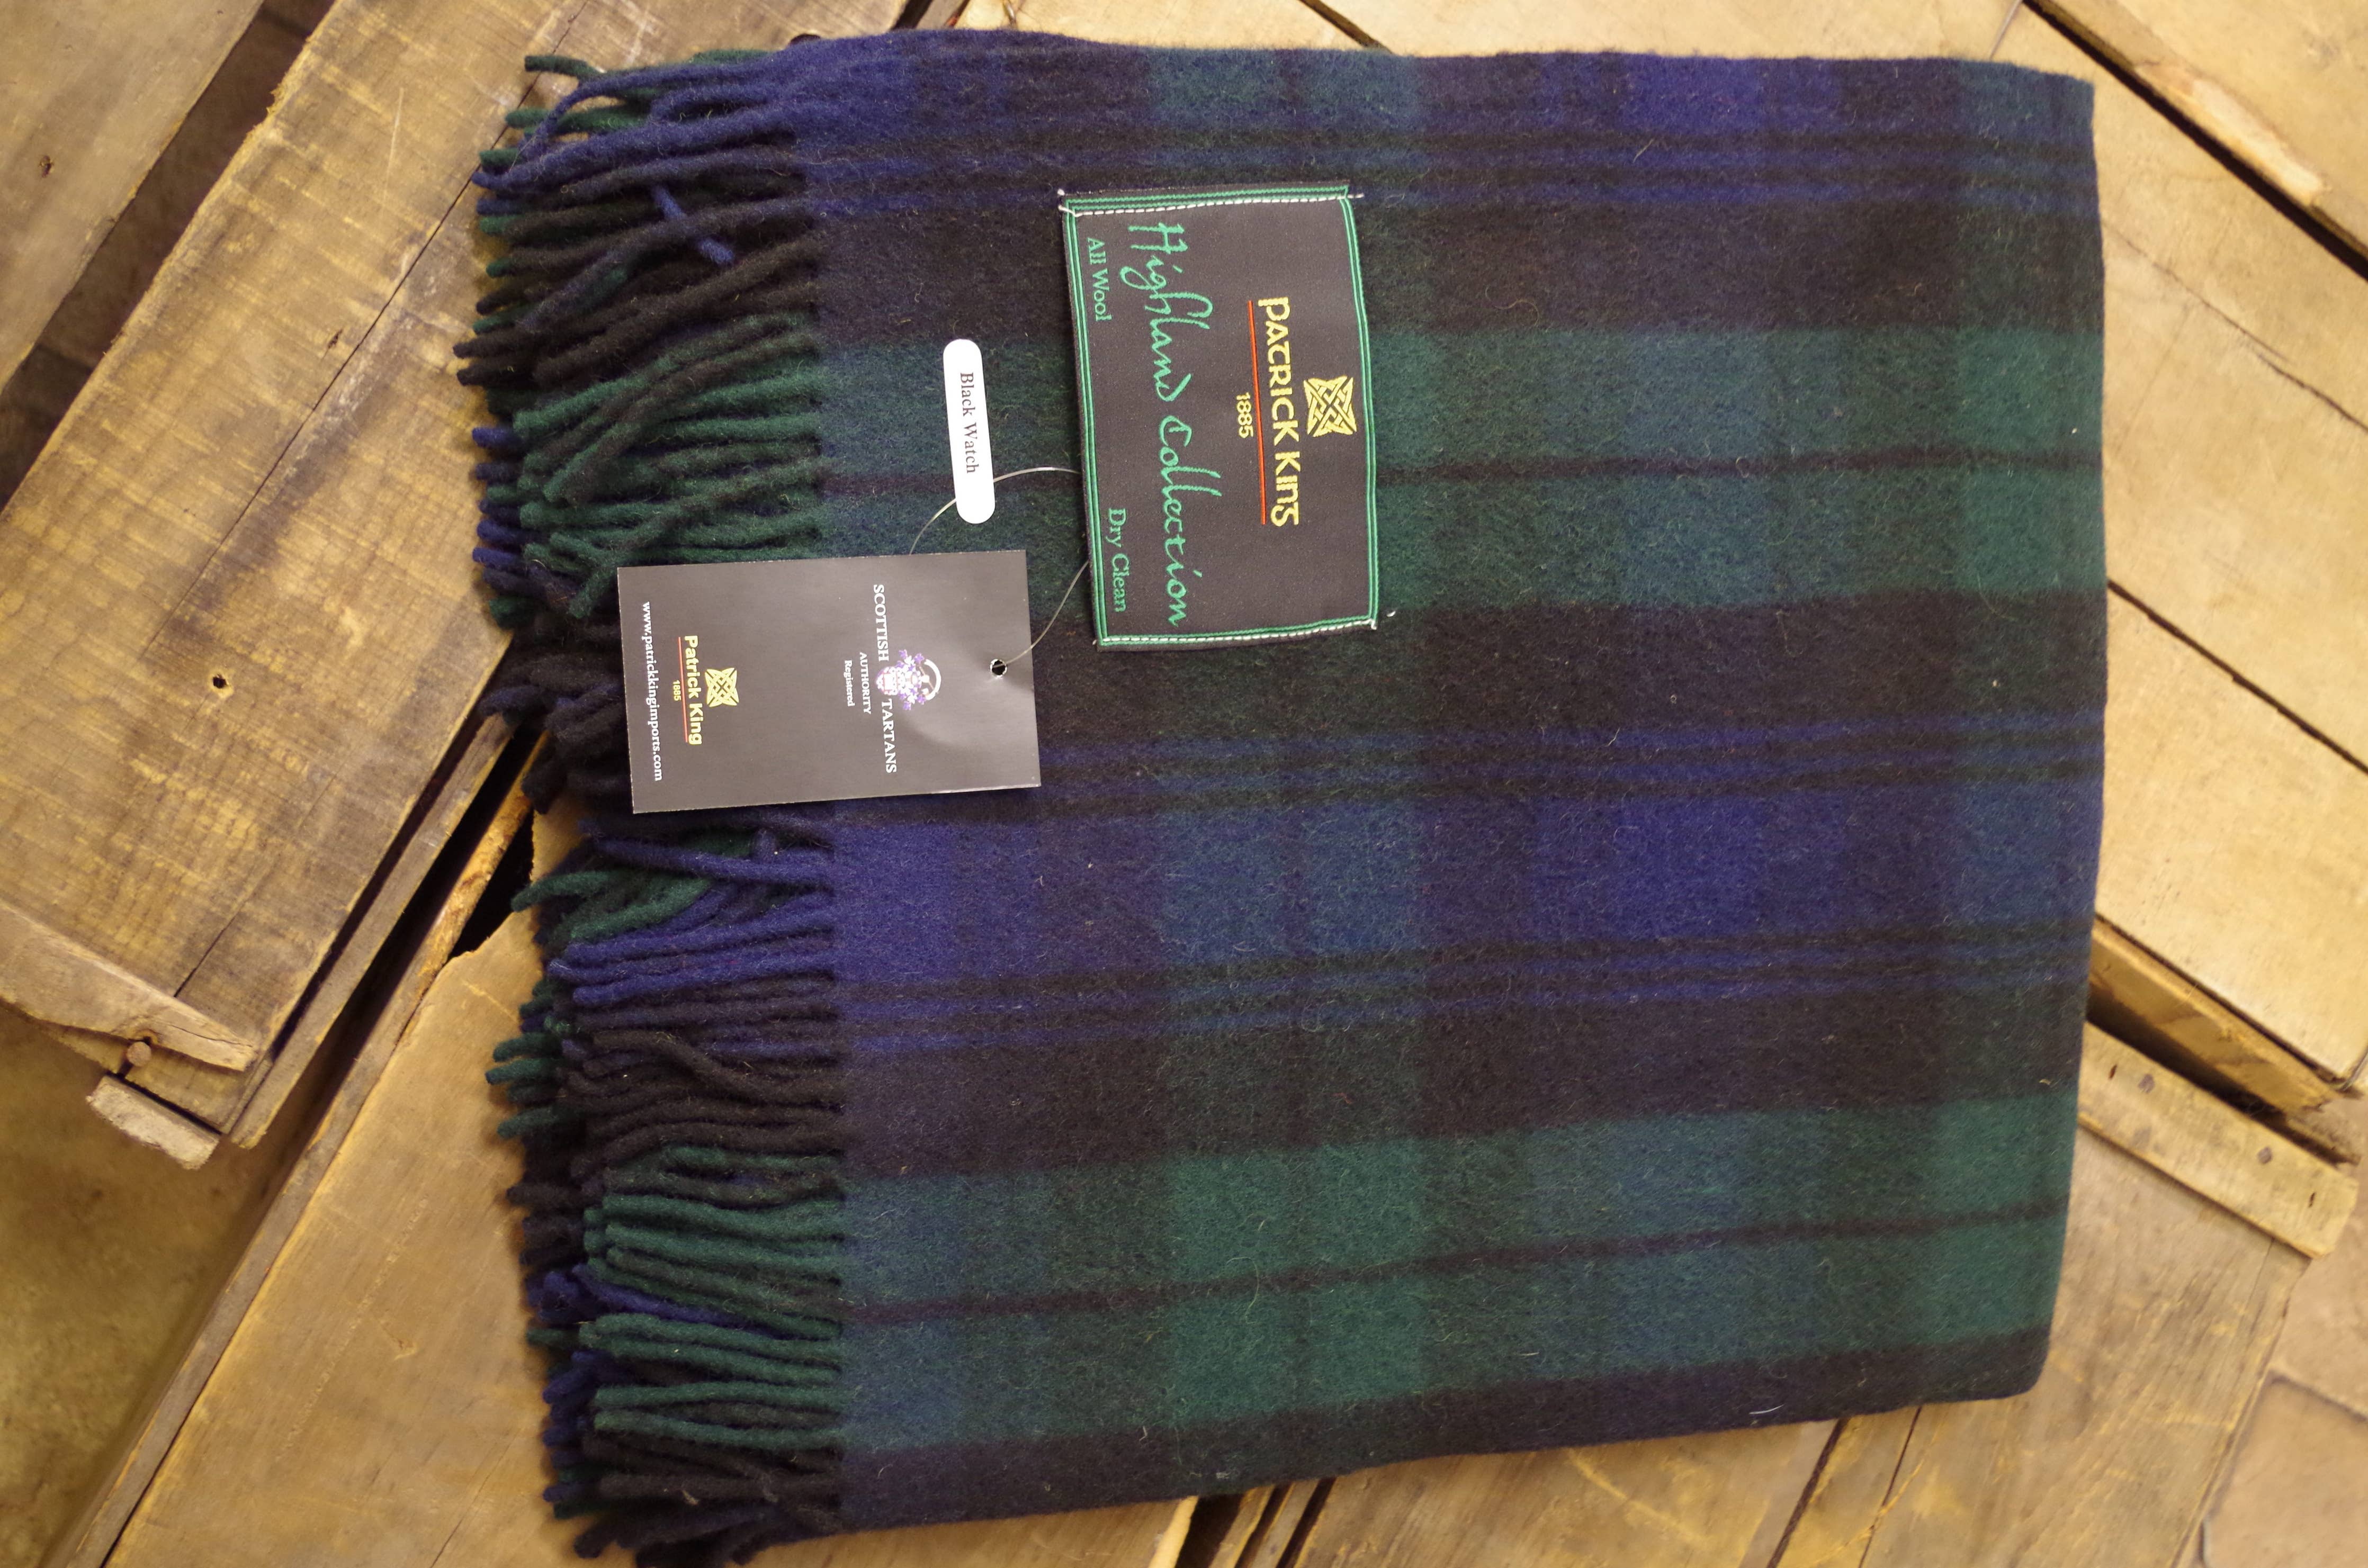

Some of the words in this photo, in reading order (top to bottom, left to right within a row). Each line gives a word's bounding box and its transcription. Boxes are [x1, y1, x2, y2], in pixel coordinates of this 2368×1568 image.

[1087, 237, 1106, 265] All
[1090, 268, 1112, 321] Wool
[1119, 222, 1213, 401] Highland
[960, 372, 975, 417] Black
[1235, 392, 1253, 438] 1885
[964, 422, 979, 474] Watch
[1108, 508, 1126, 547] Dry
[1159, 415, 1222, 625] Collection
[1111, 552, 1129, 612] Clean
[873, 584, 890, 661] SCOTTISH
[641, 601, 662, 781] www.patrickkingimports.com
[672, 680, 681, 701] 1885
[684, 635, 701, 698] Patrick
[844, 660, 855, 706] Registered
[859, 652, 871, 714] AUTHORITY
[688, 703, 704, 745] King
[881, 699, 897, 773] TARTANS
